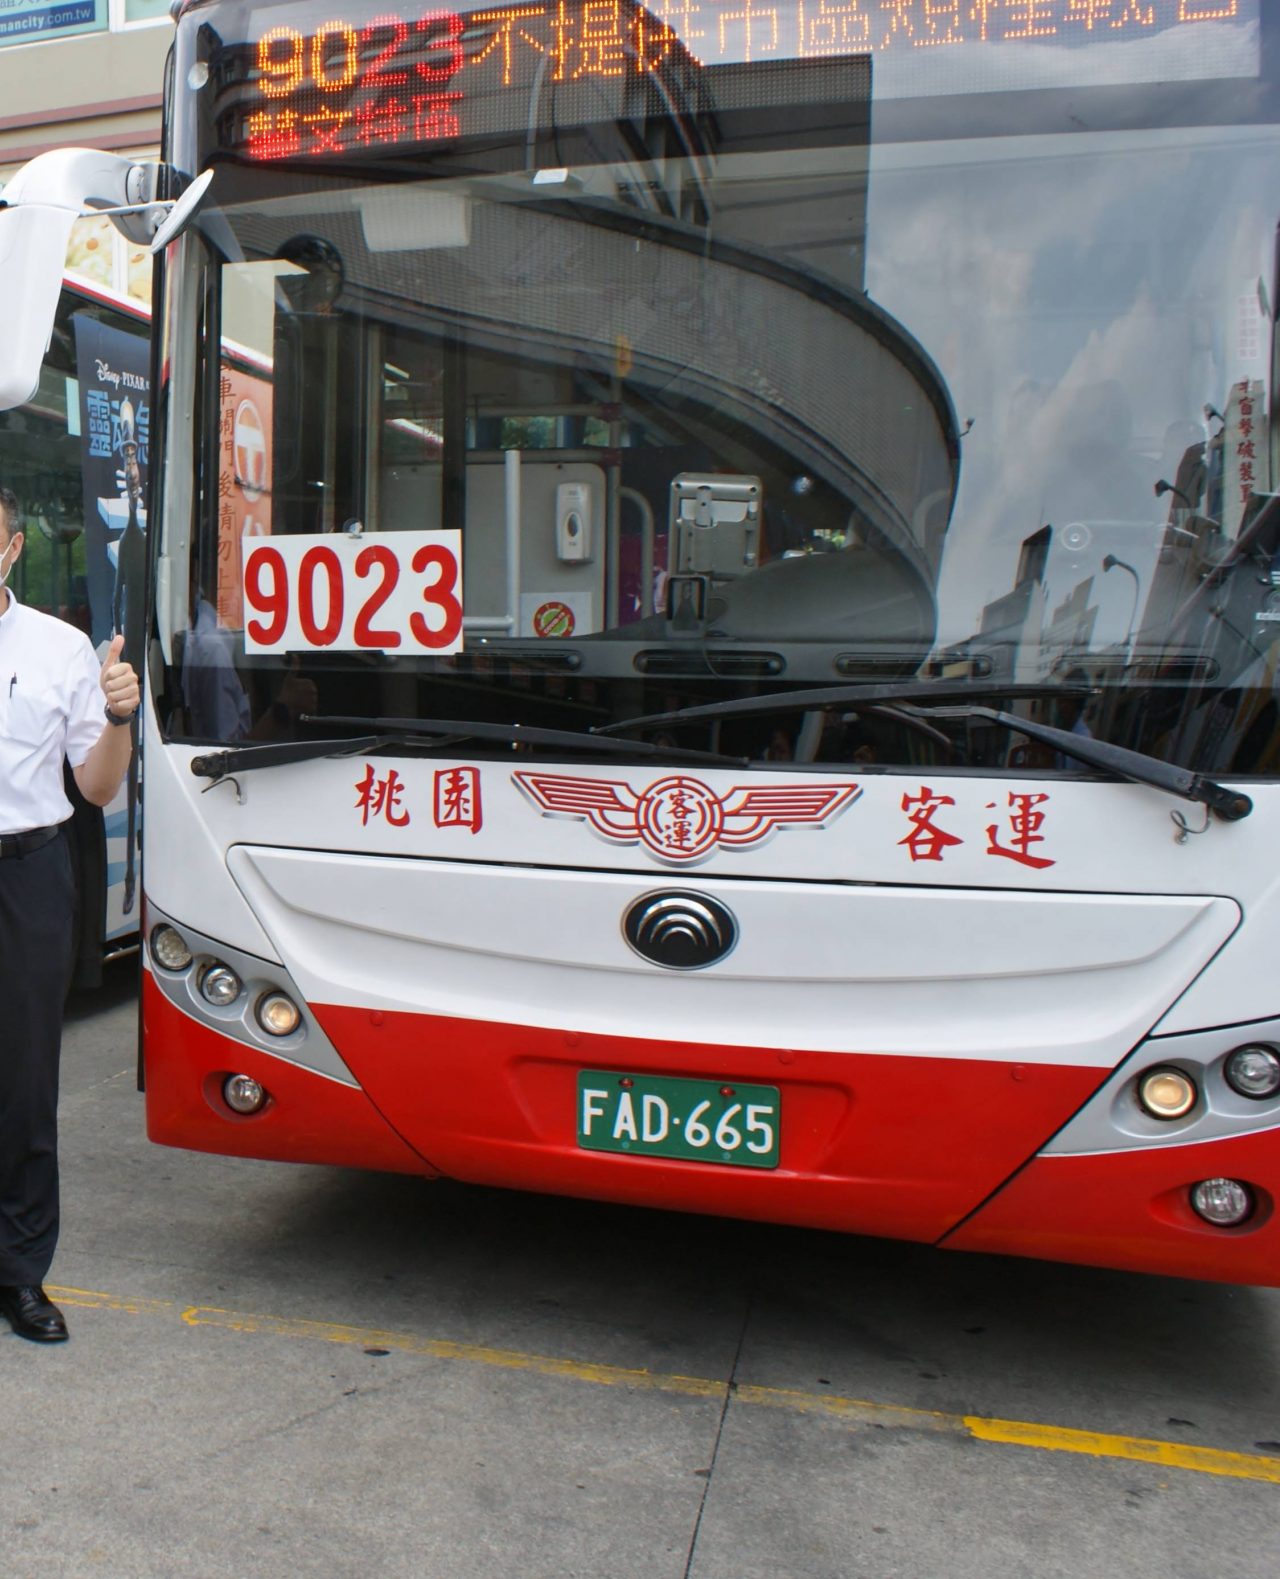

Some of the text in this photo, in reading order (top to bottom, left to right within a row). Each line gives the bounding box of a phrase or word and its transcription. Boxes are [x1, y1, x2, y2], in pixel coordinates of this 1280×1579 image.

[257, 8, 466, 98] 9023
[249, 92, 464, 161] 藝文特區
[95, 359, 145, 391] Disney PIXAR
[244, 544, 464, 649] 9023
[353, 762, 484, 836] 桃園
[665, 789, 697, 853] 客運
[896, 785, 1057, 870] 客運
